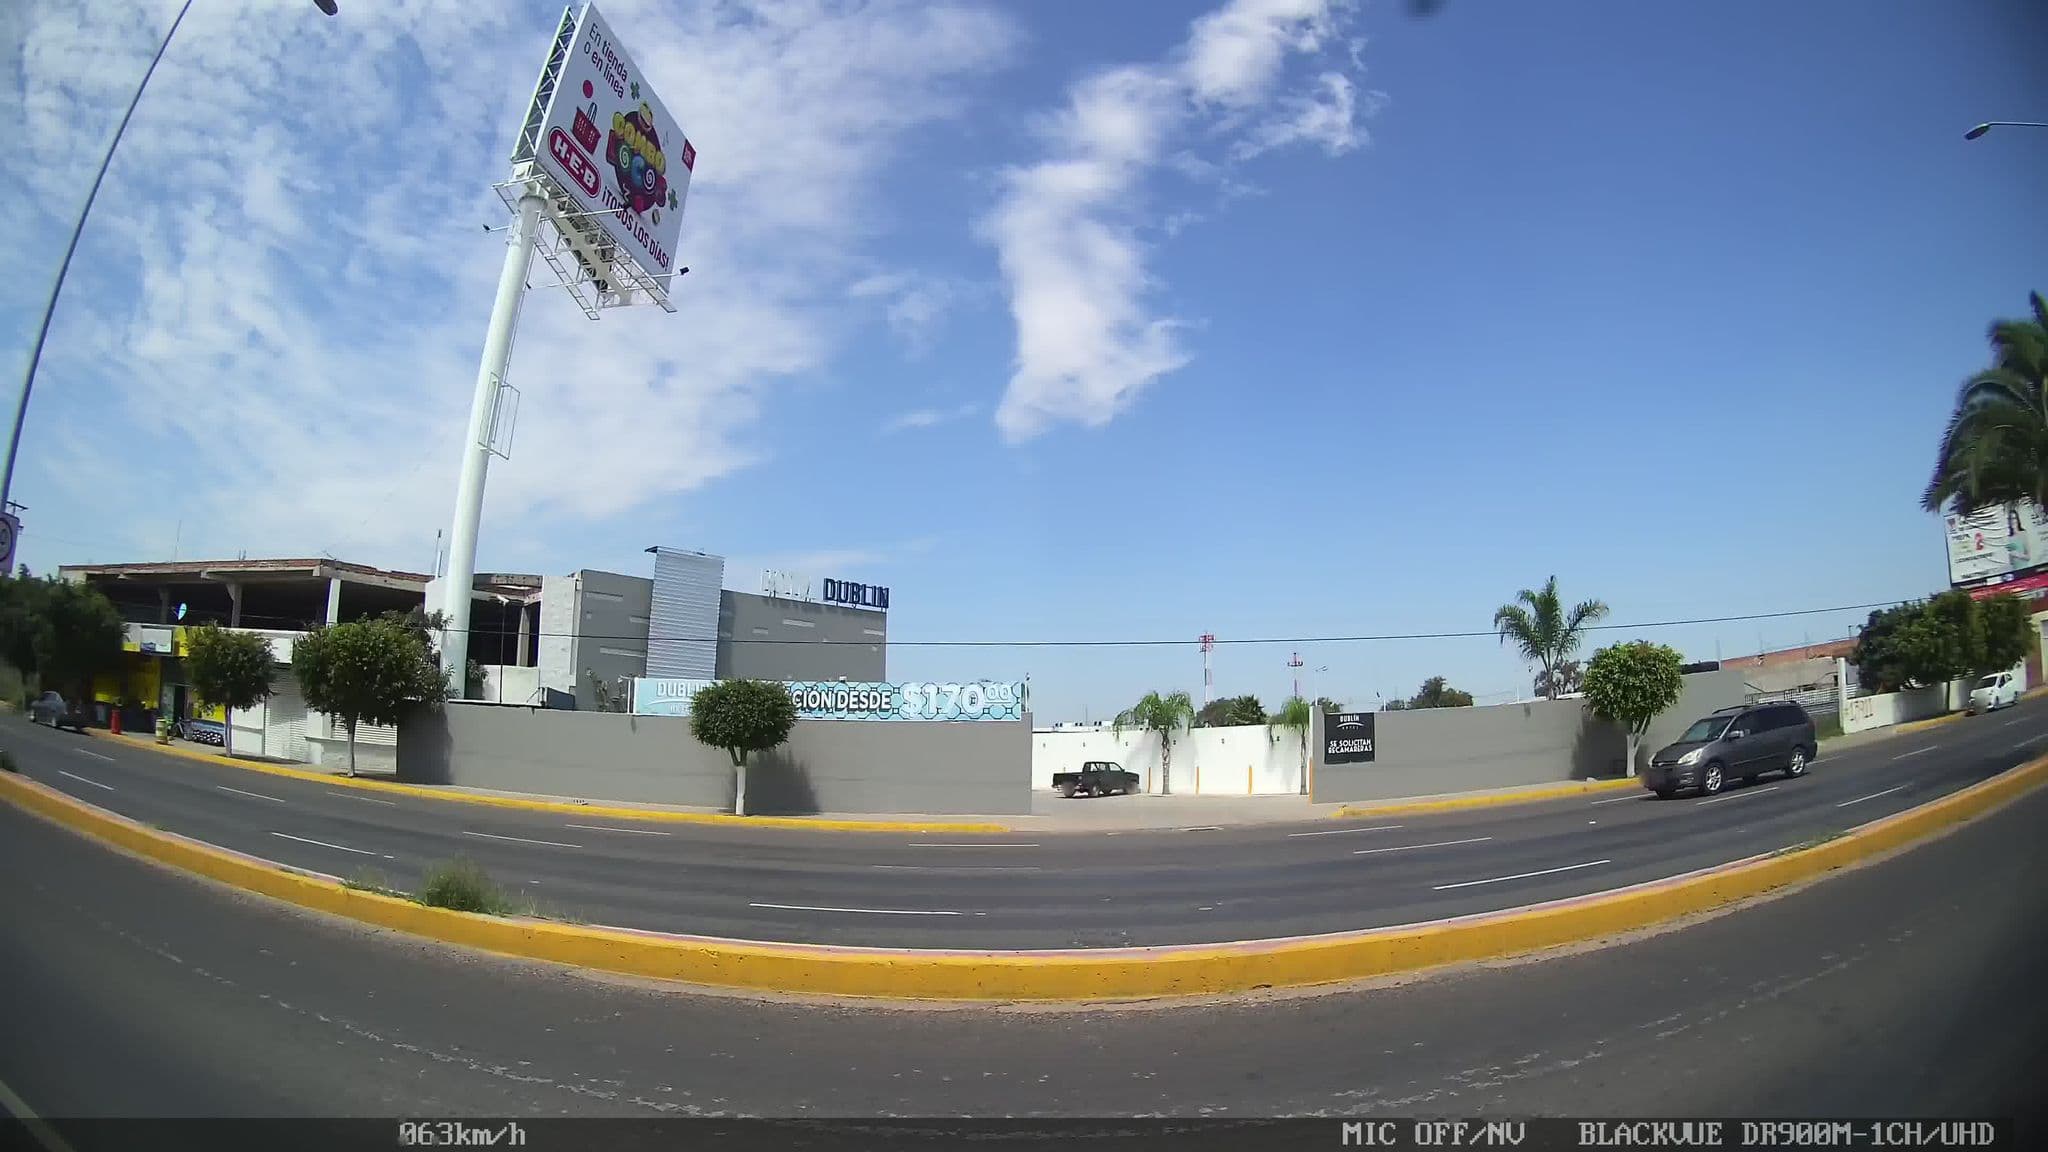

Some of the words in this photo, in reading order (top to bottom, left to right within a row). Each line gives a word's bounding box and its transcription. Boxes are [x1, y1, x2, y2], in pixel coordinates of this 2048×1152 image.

[584, 41, 591, 54] o
[591, 51, 604, 72] en
[589, 22, 602, 47] En
[602, 40, 628, 82] tienda
[602, 186, 634, 231] ¡TODOS
[633, 221, 650, 249] LOS
[649, 239, 670, 272] DÍAS!
[823, 577, 890, 609] DUBLIN
[836, 690, 893, 711] DESDE
[1339, 738, 1371, 746] SOLICITAN
